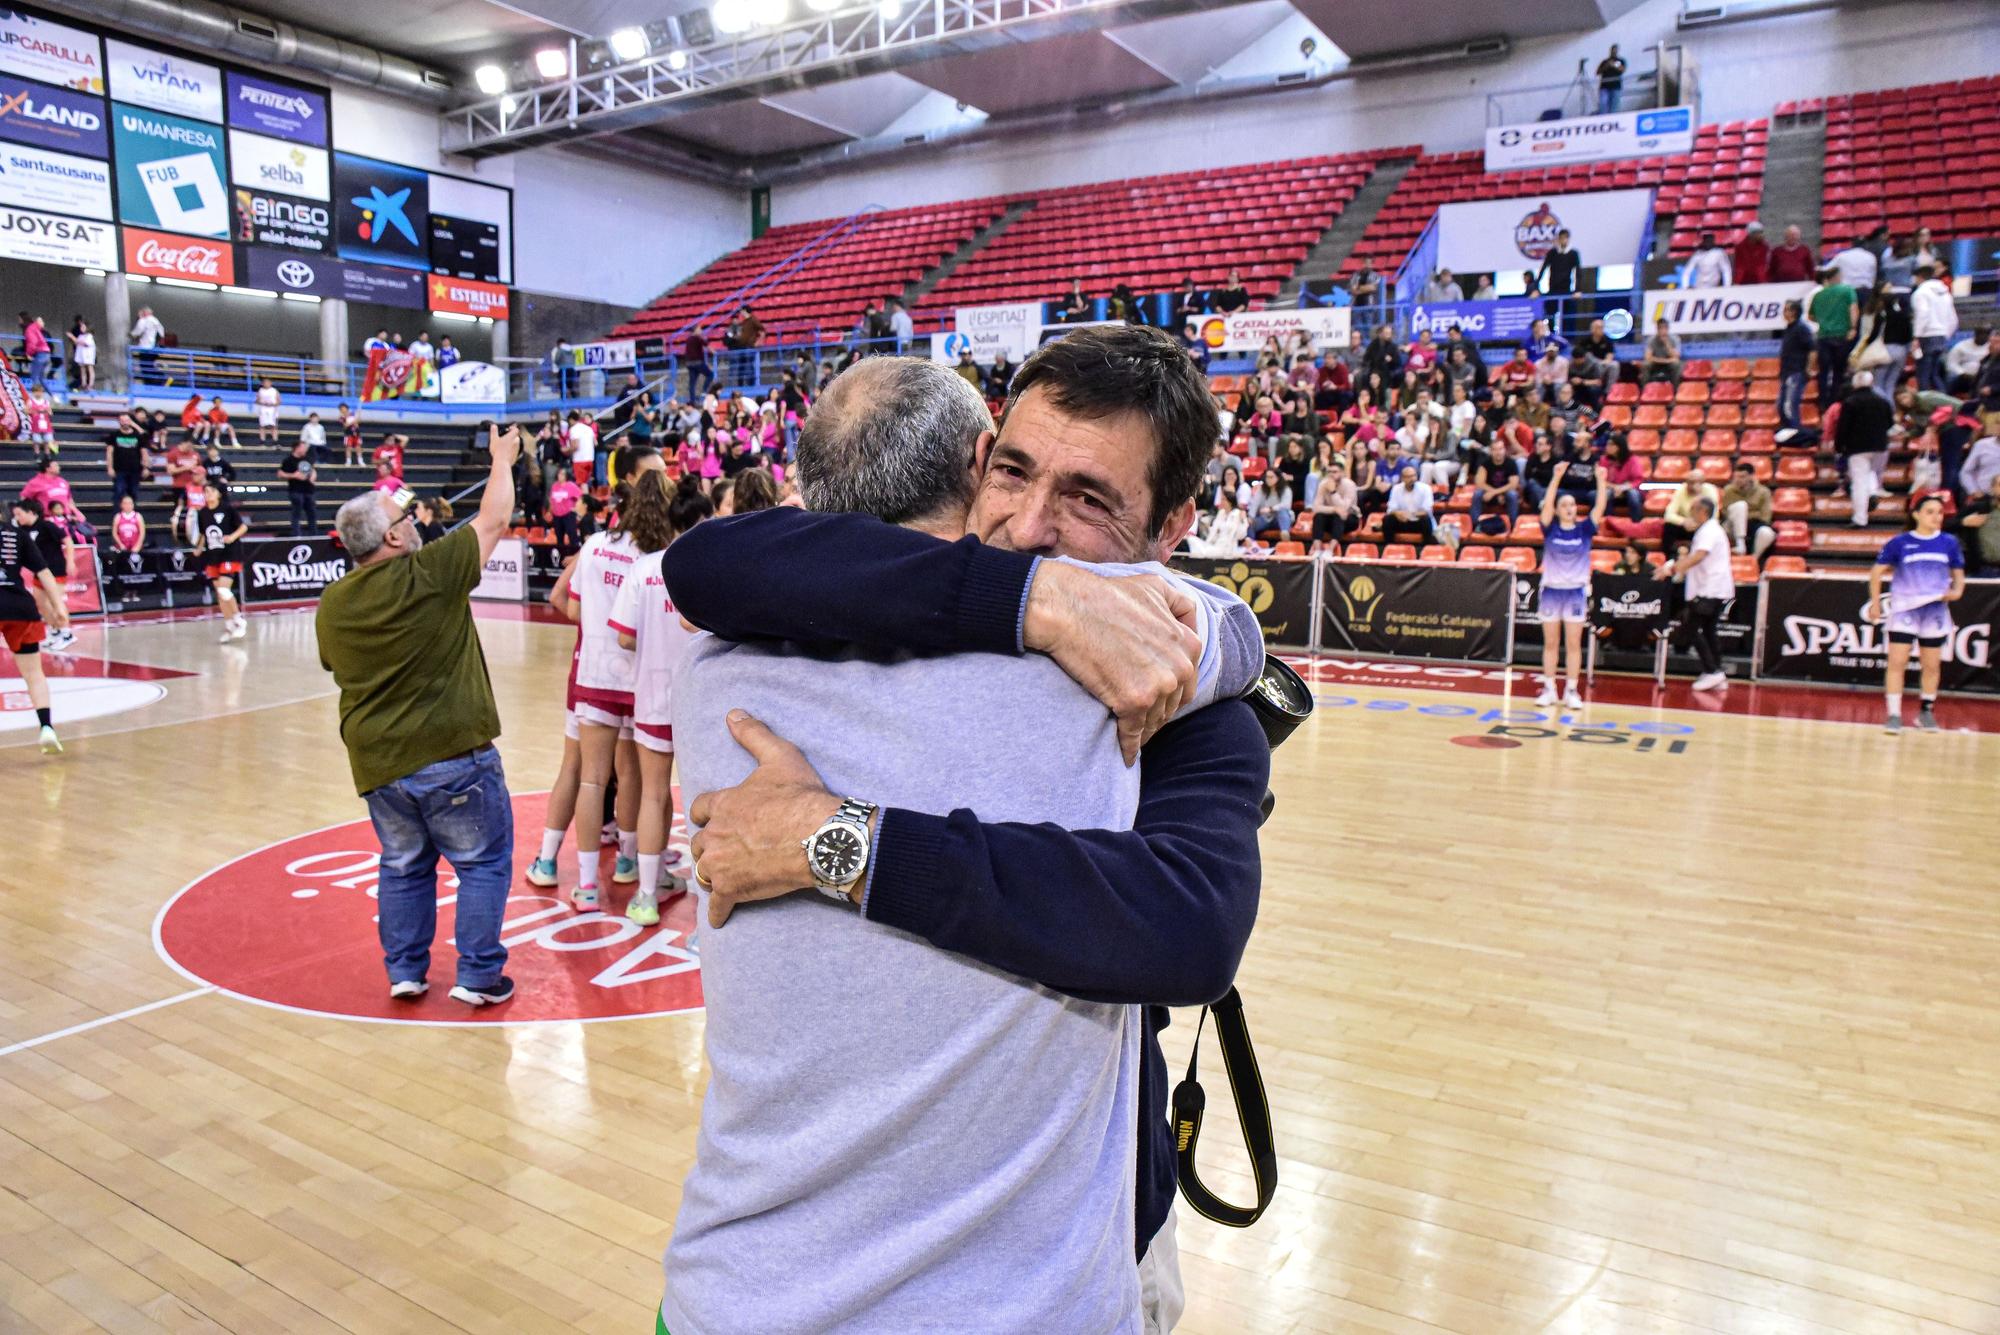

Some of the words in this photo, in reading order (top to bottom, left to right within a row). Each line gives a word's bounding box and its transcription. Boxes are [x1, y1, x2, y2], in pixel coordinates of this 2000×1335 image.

[132, 64, 201, 93] VITAM
[0, 91, 100, 130] XLAND
[122, 115, 217, 149] UMANRESA
[1532, 121, 1627, 141] CONTROL
[10, 157, 105, 182] santasusana
[146, 165, 179, 184] FUB
[260, 163, 303, 184] selba
[1, 213, 104, 243] JOYSAT
[137, 239, 221, 277] Coca-Cola
[450, 287, 507, 307] ESTRELLA
[252, 558, 345, 588] SPALDING
[485, 560, 518, 573] arxa
[1600, 597, 1661, 615] SPALDING
[1782, 615, 1990, 668] SPALG
[1178, 1119, 1194, 1152] Nikon
